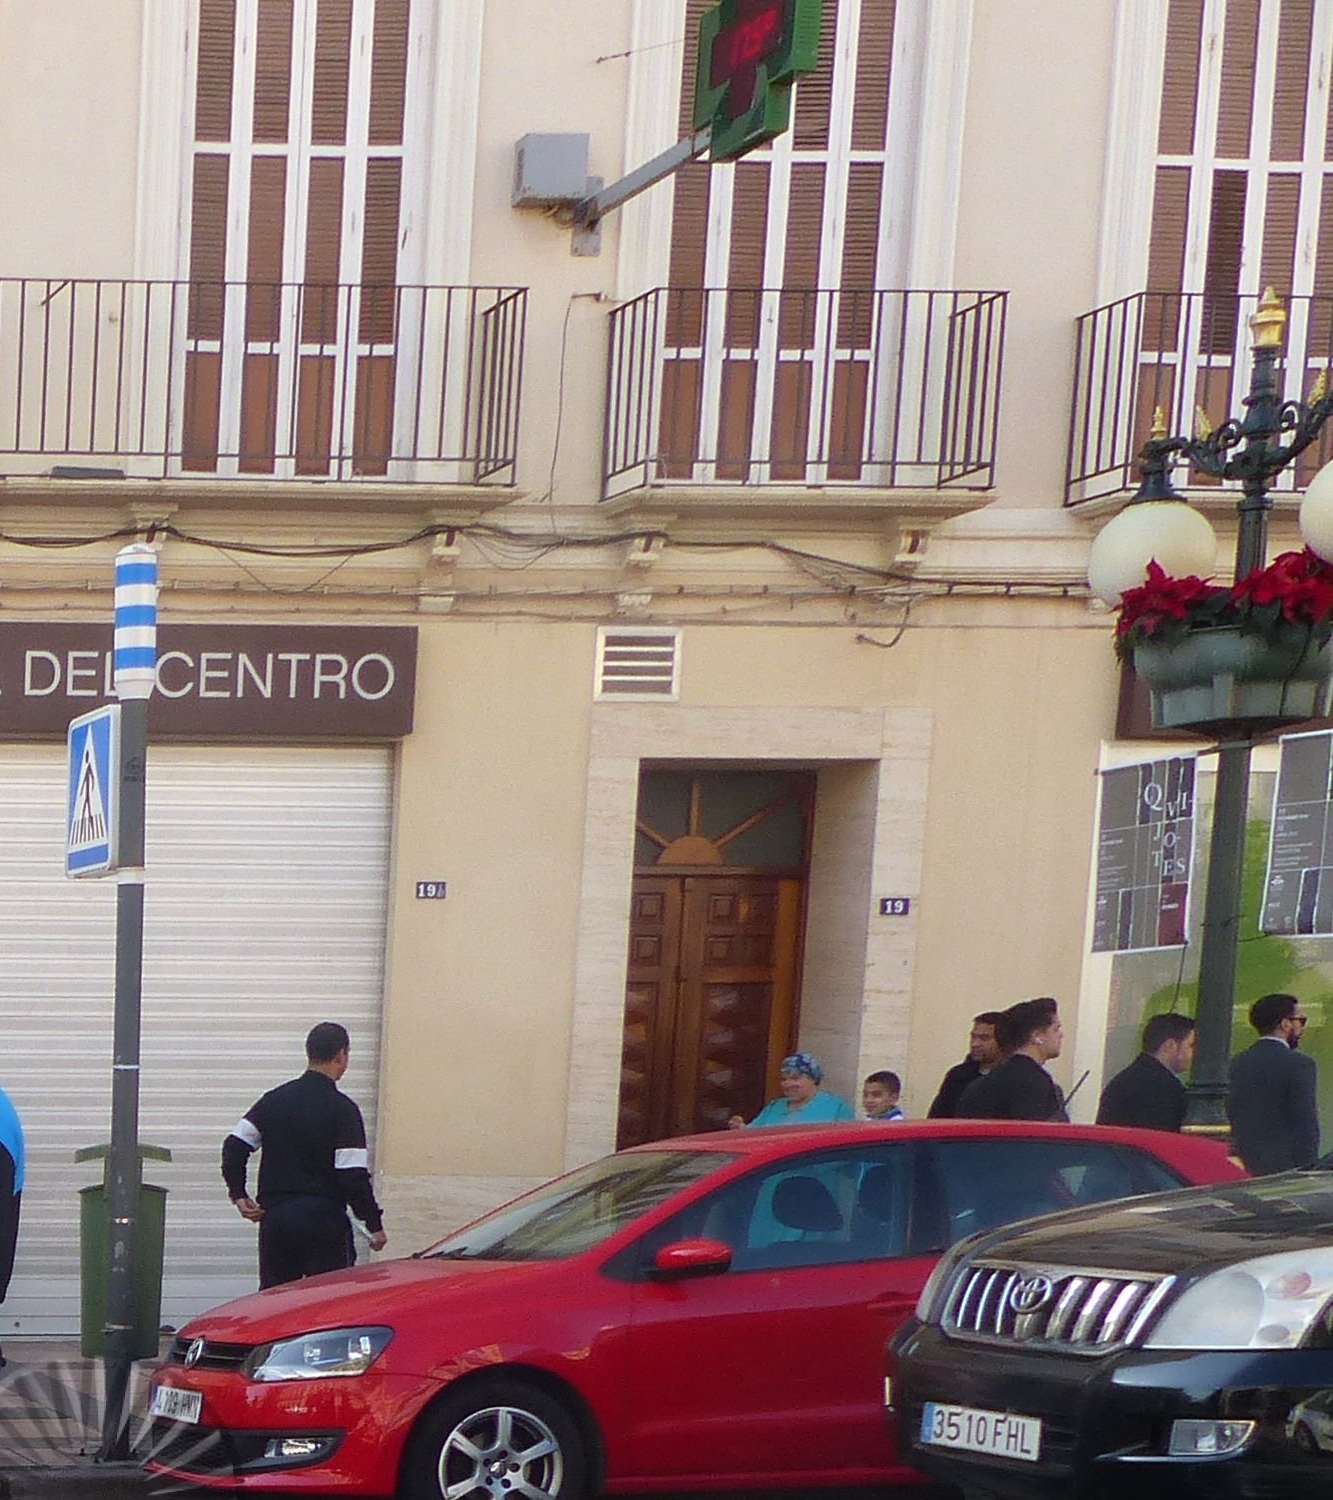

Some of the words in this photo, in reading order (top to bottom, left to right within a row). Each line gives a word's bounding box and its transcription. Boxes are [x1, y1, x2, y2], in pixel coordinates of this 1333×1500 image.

[23, 650, 115, 697] DEL
[154, 651, 396, 701] CENTRO
[885, 899, 904, 914] 19
[933, 1408, 988, 1447] 3510
[993, 1415, 1032, 1456] FHL
